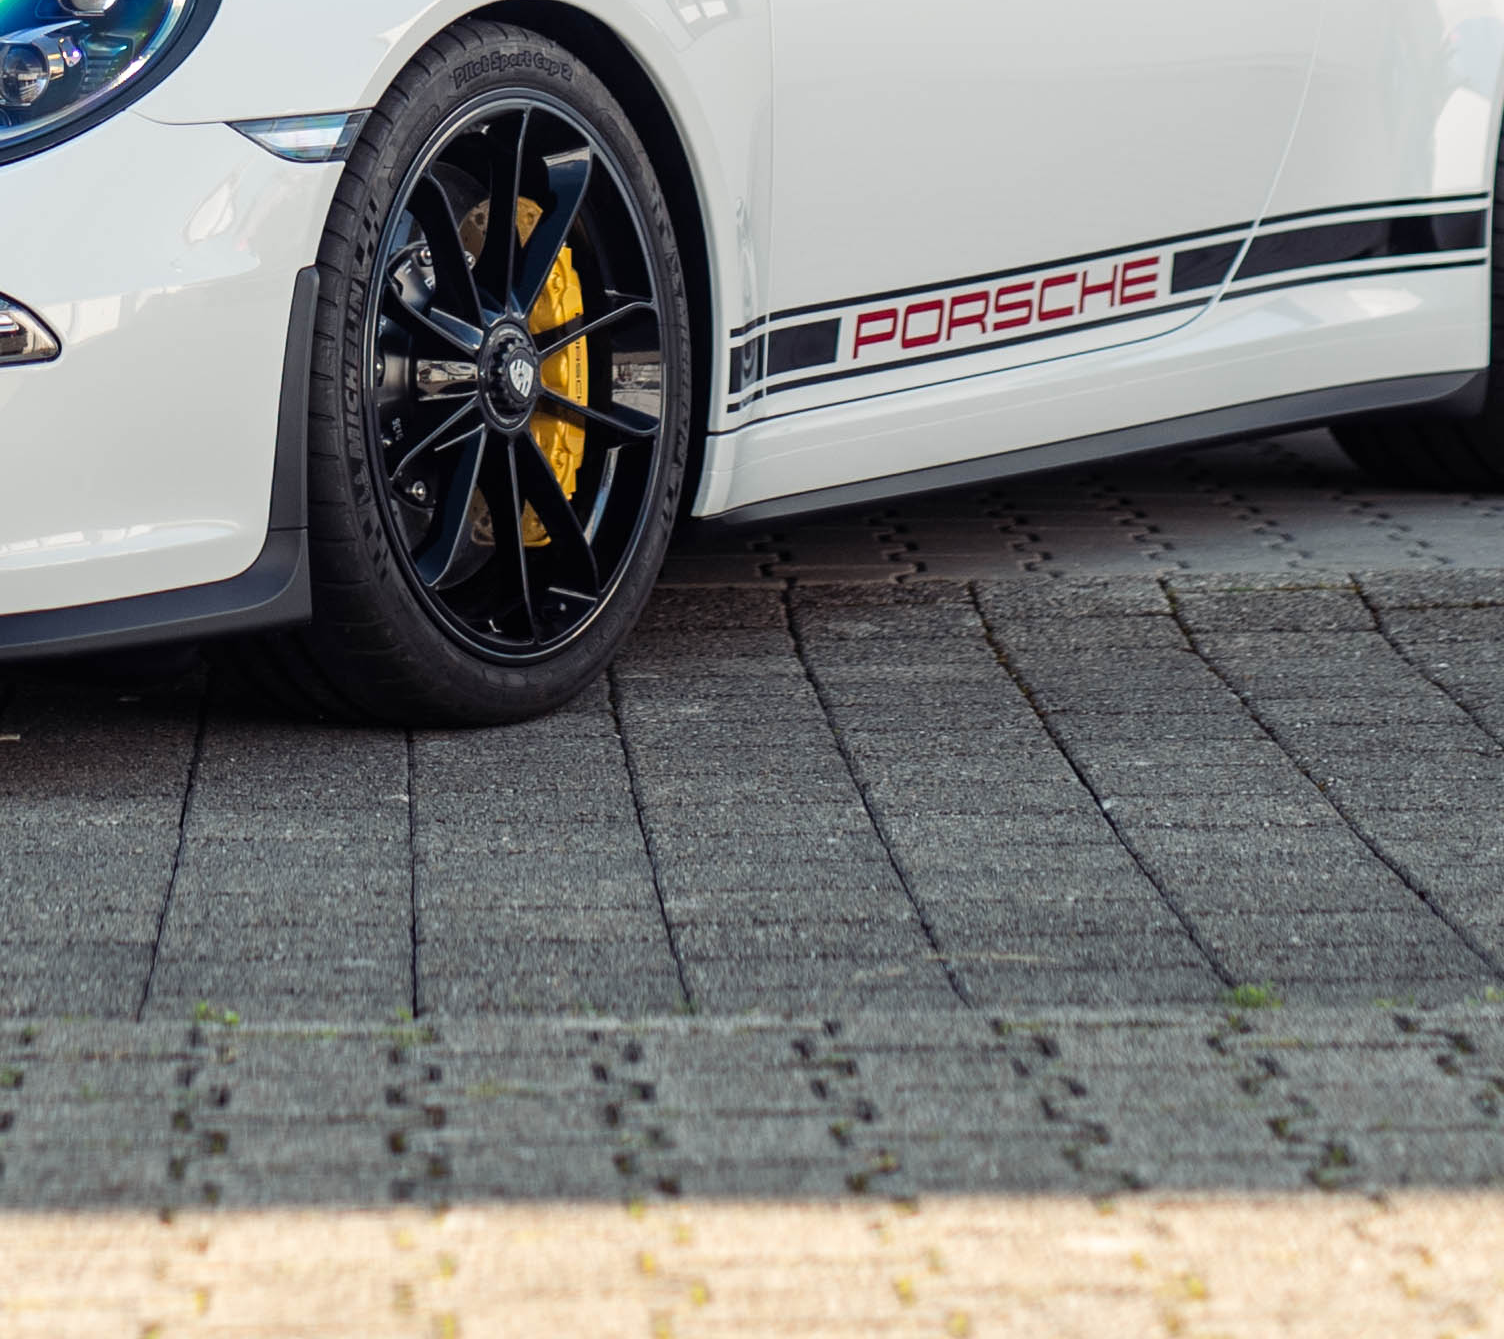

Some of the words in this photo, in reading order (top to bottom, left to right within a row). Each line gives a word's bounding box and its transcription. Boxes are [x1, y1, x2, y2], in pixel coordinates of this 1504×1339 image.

[453, 55, 490, 90] Pilot
[490, 51, 532, 72] Sport
[533, 52, 560, 76] Cup
[561, 63, 573, 82] 2
[852, 255, 1161, 359] PORSCHE
[344, 279, 366, 459] MICHELIN
